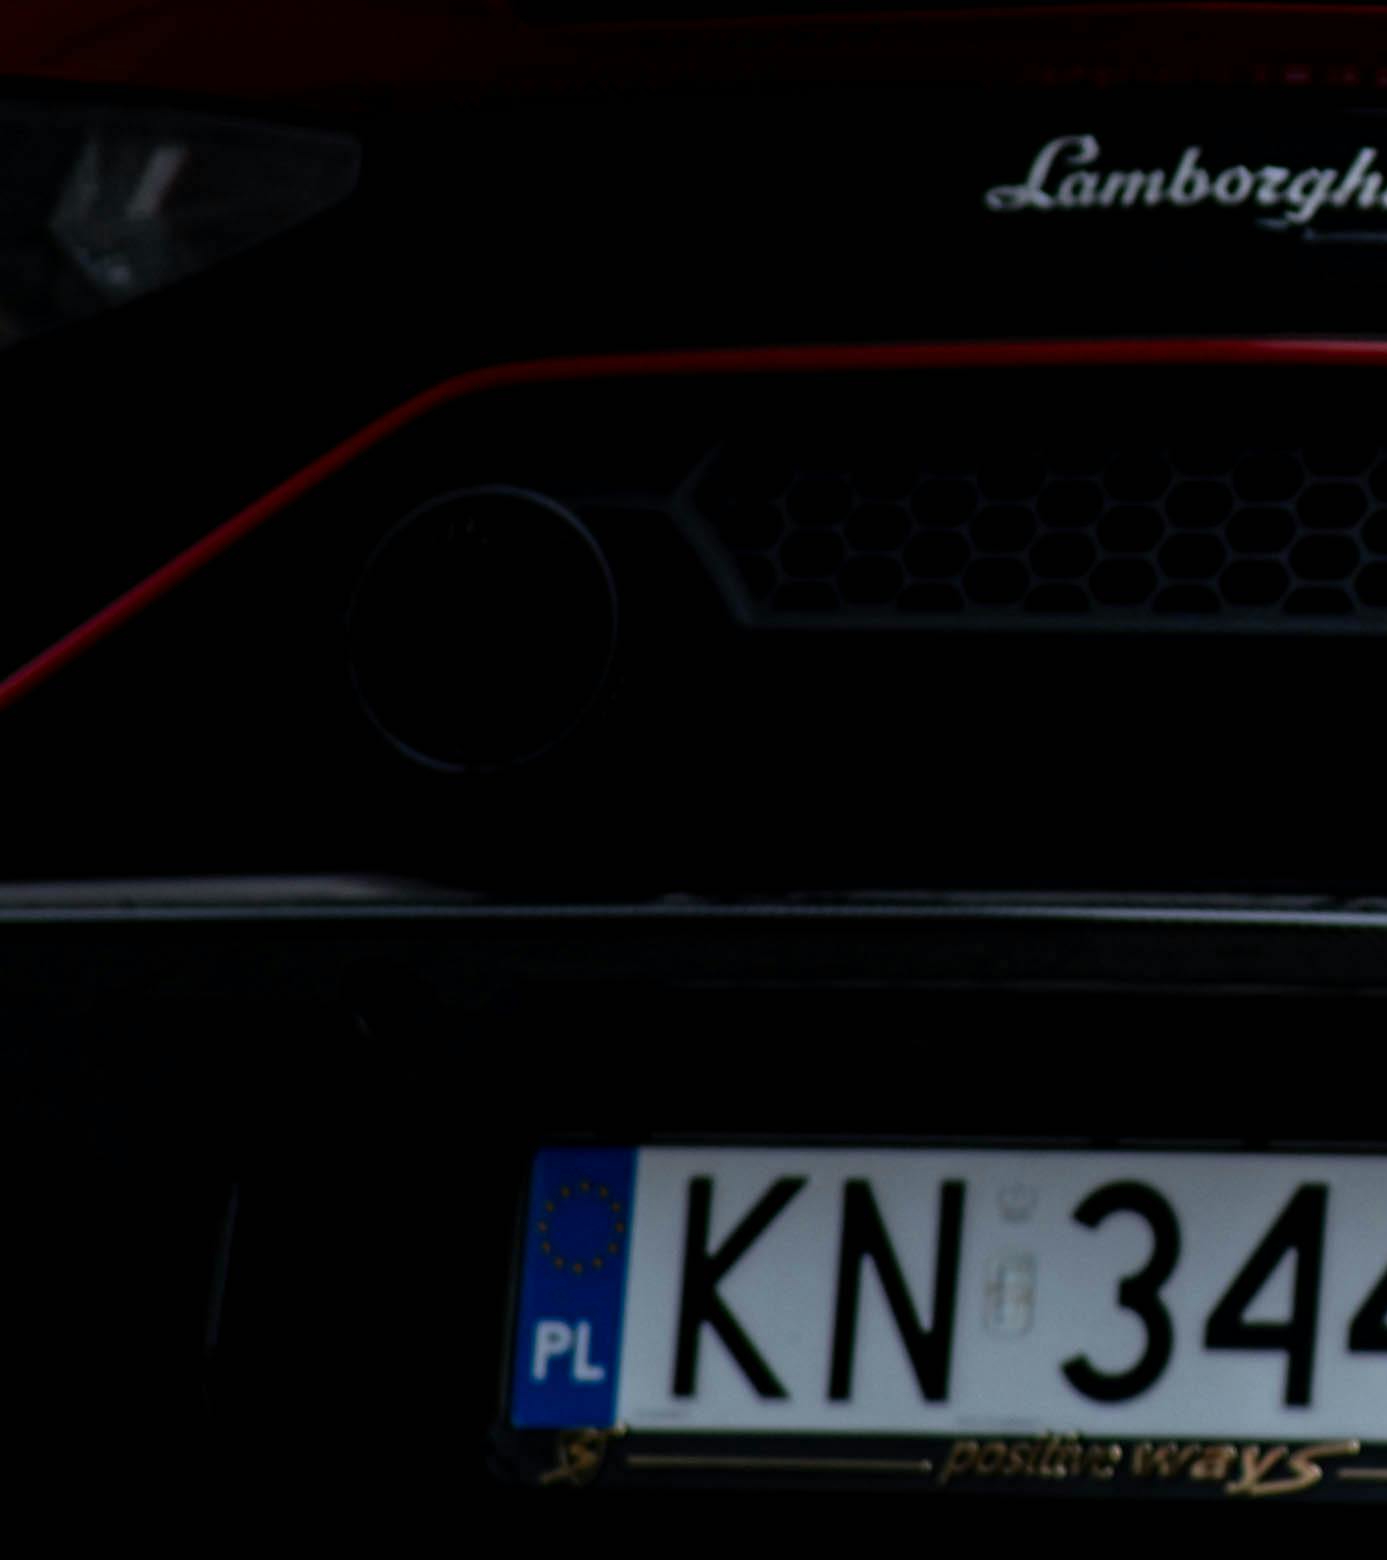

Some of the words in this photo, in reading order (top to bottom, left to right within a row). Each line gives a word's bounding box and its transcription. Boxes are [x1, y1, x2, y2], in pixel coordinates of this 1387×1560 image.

[674, 1177, 966, 1400] KN
[531, 1317, 607, 1383] PL
[936, 1432, 1124, 1486] positive
[1127, 1438, 1362, 1498] ways
